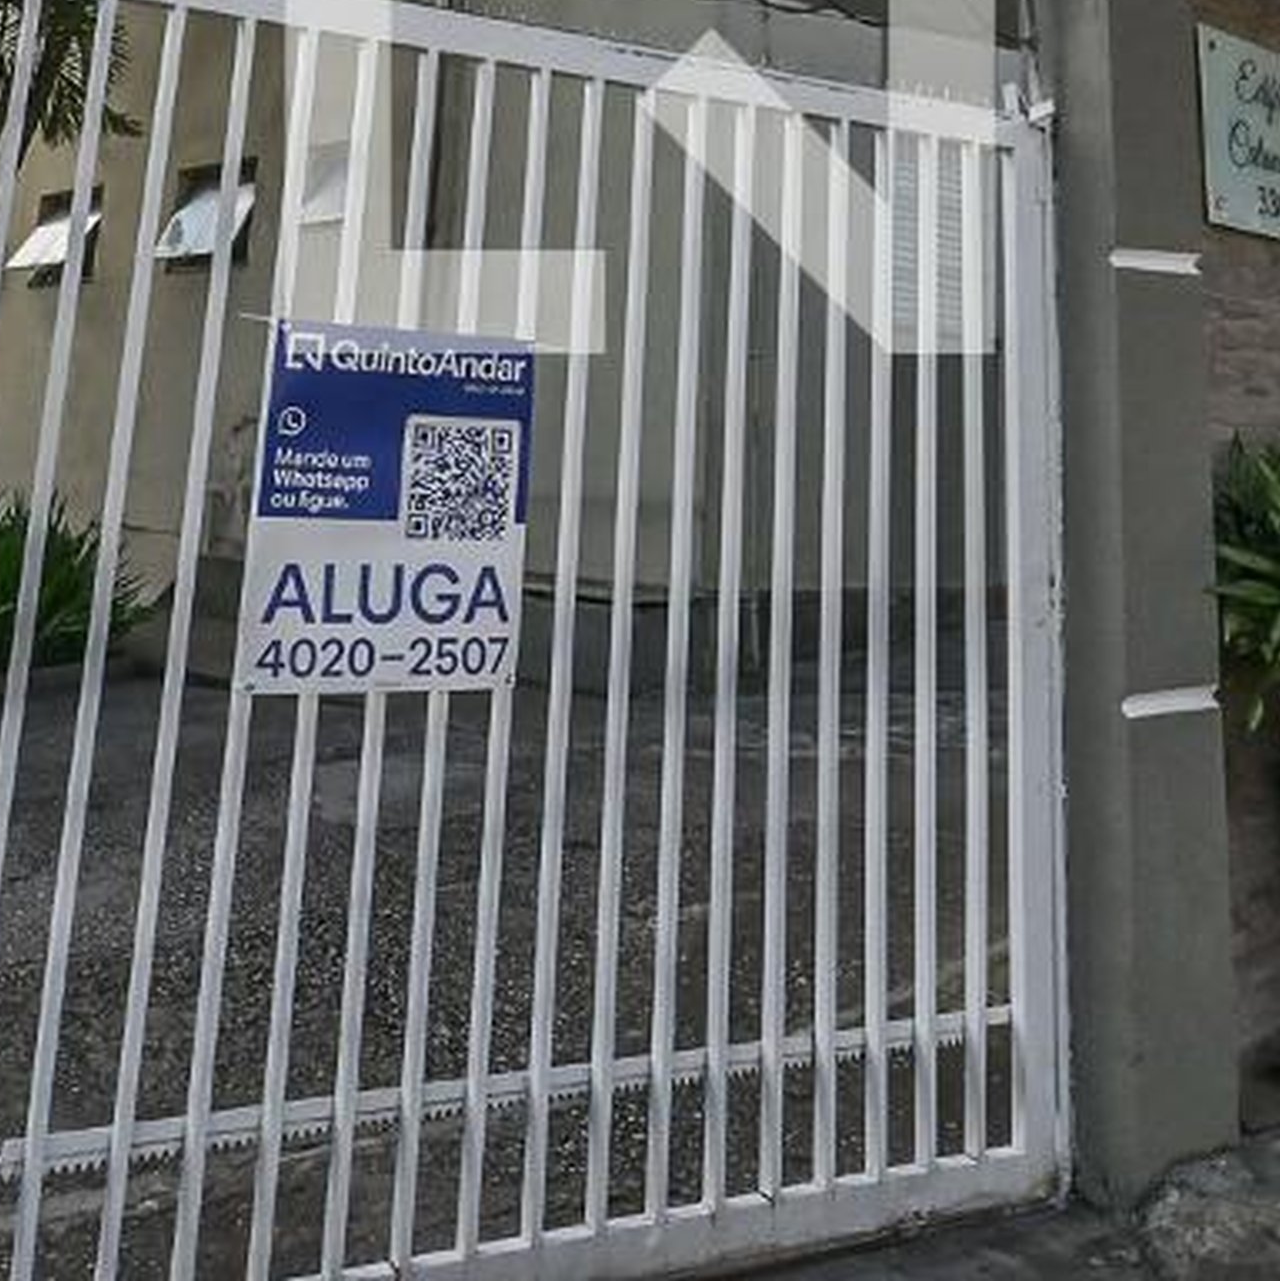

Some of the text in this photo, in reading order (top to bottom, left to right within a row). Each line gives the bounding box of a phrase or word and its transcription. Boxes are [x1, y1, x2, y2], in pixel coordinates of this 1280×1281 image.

[331, 338, 526, 382] QuintoAndar
[274, 446, 372, 469] Mande um
[270, 493, 296, 508] ou
[261, 563, 510, 625] ALUGA
[255, 636, 510, 678] 4020-2507
